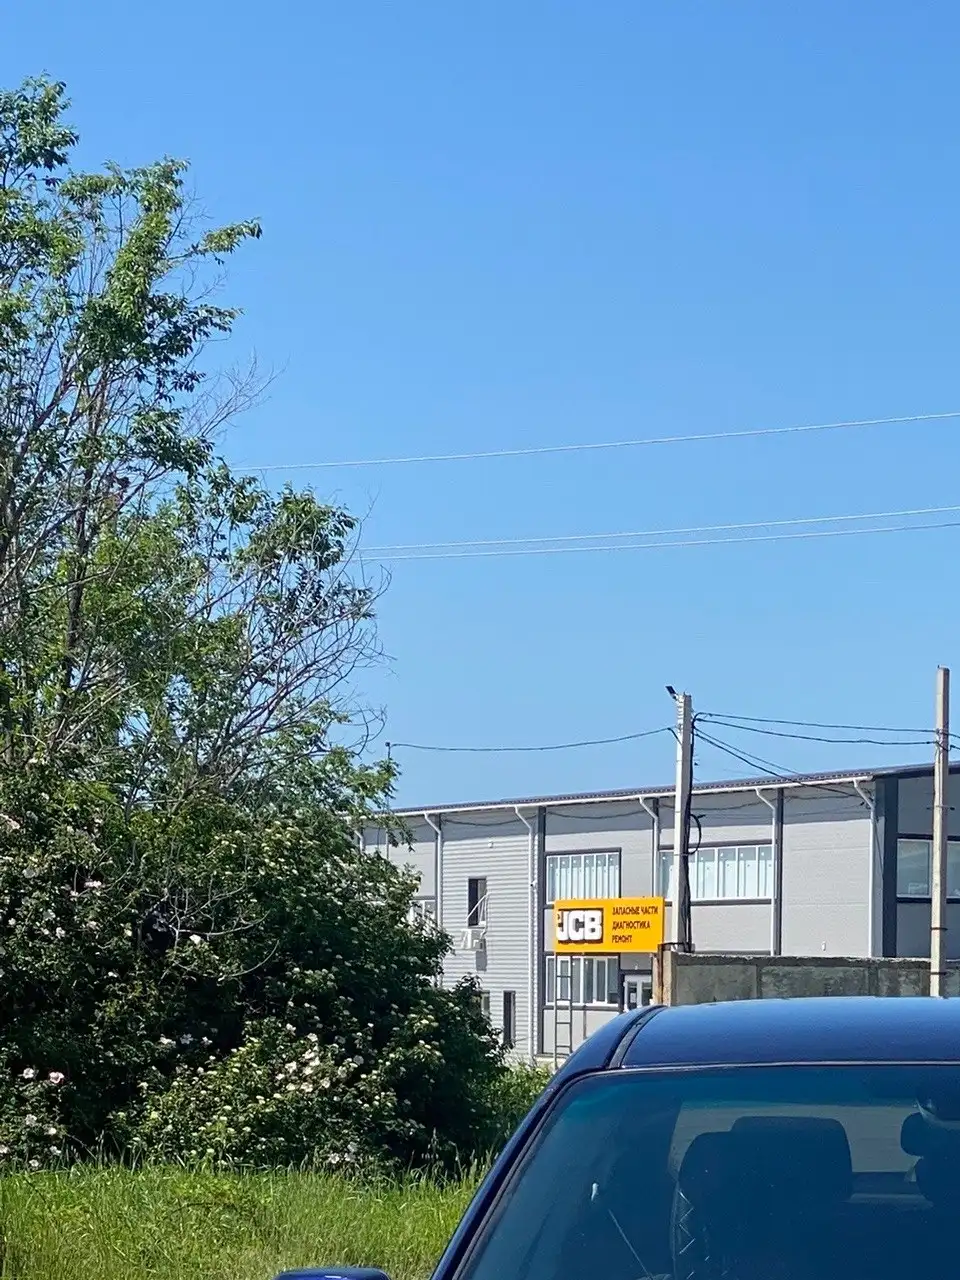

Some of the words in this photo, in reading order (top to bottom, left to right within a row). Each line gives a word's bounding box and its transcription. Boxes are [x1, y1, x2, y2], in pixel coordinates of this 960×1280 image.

[612, 906, 640, 915] ЗАПАСНЫЕ
[640, 905, 659, 915] ЧАСТИ
[556, 909, 604, 942] JCB
[612, 920, 651, 930] ДИАГНОСТИКА
[612, 934, 633, 943] РЕМОНТ
